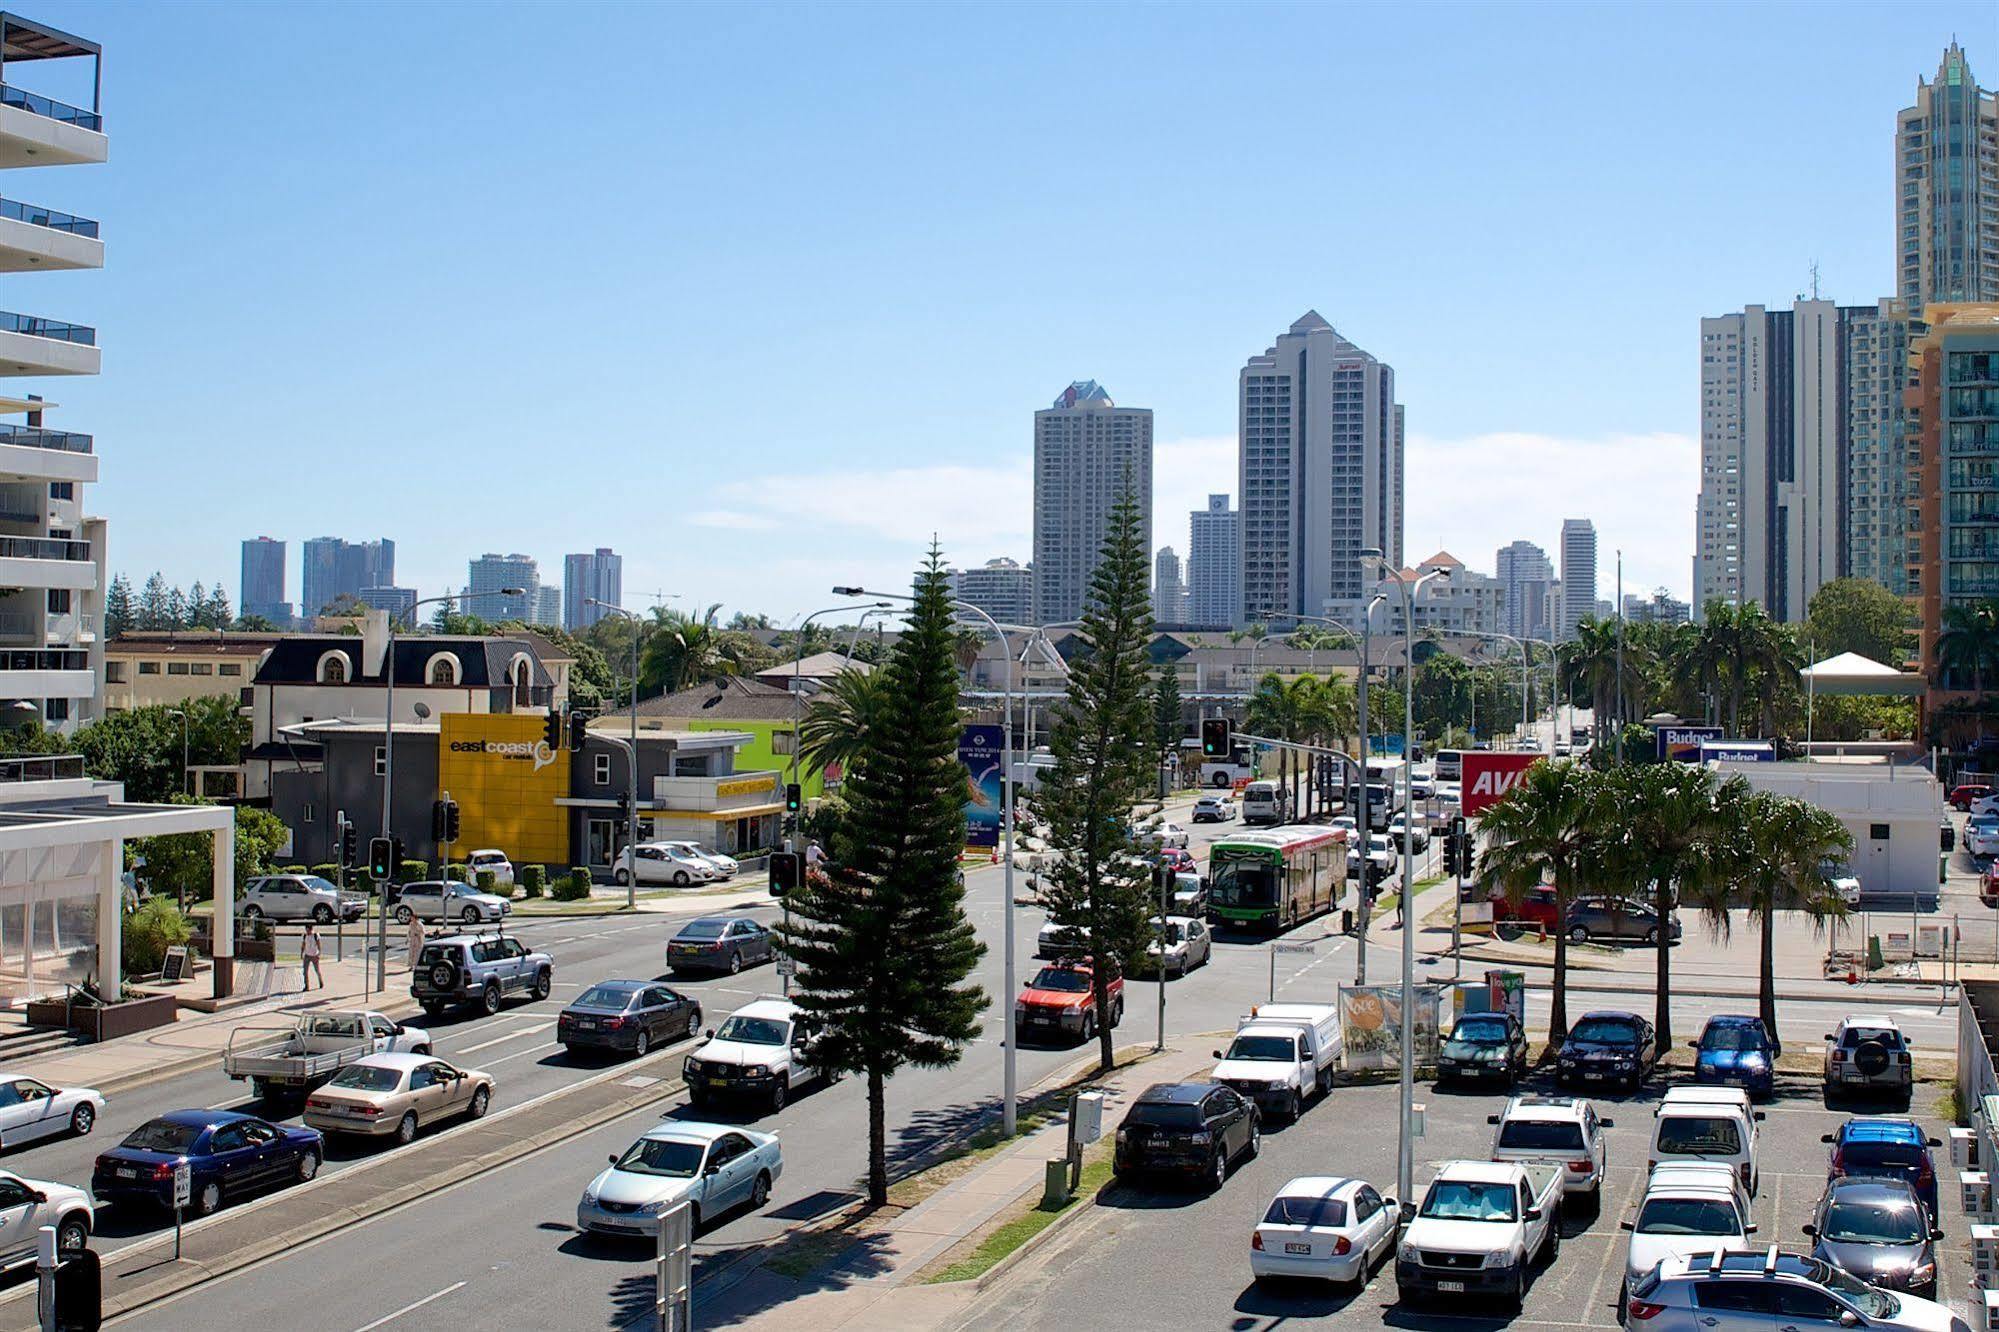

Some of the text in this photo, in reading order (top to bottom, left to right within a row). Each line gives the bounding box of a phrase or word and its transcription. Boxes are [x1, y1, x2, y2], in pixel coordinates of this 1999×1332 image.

[1666, 731, 1713, 747] Budget
[450, 740, 534, 753] eastcoast
[1719, 752, 1758, 761] Budget
[1471, 771, 1526, 795] AVI
[176, 1167, 189, 1182] ONE
[176, 1183, 189, 1193] WAY
